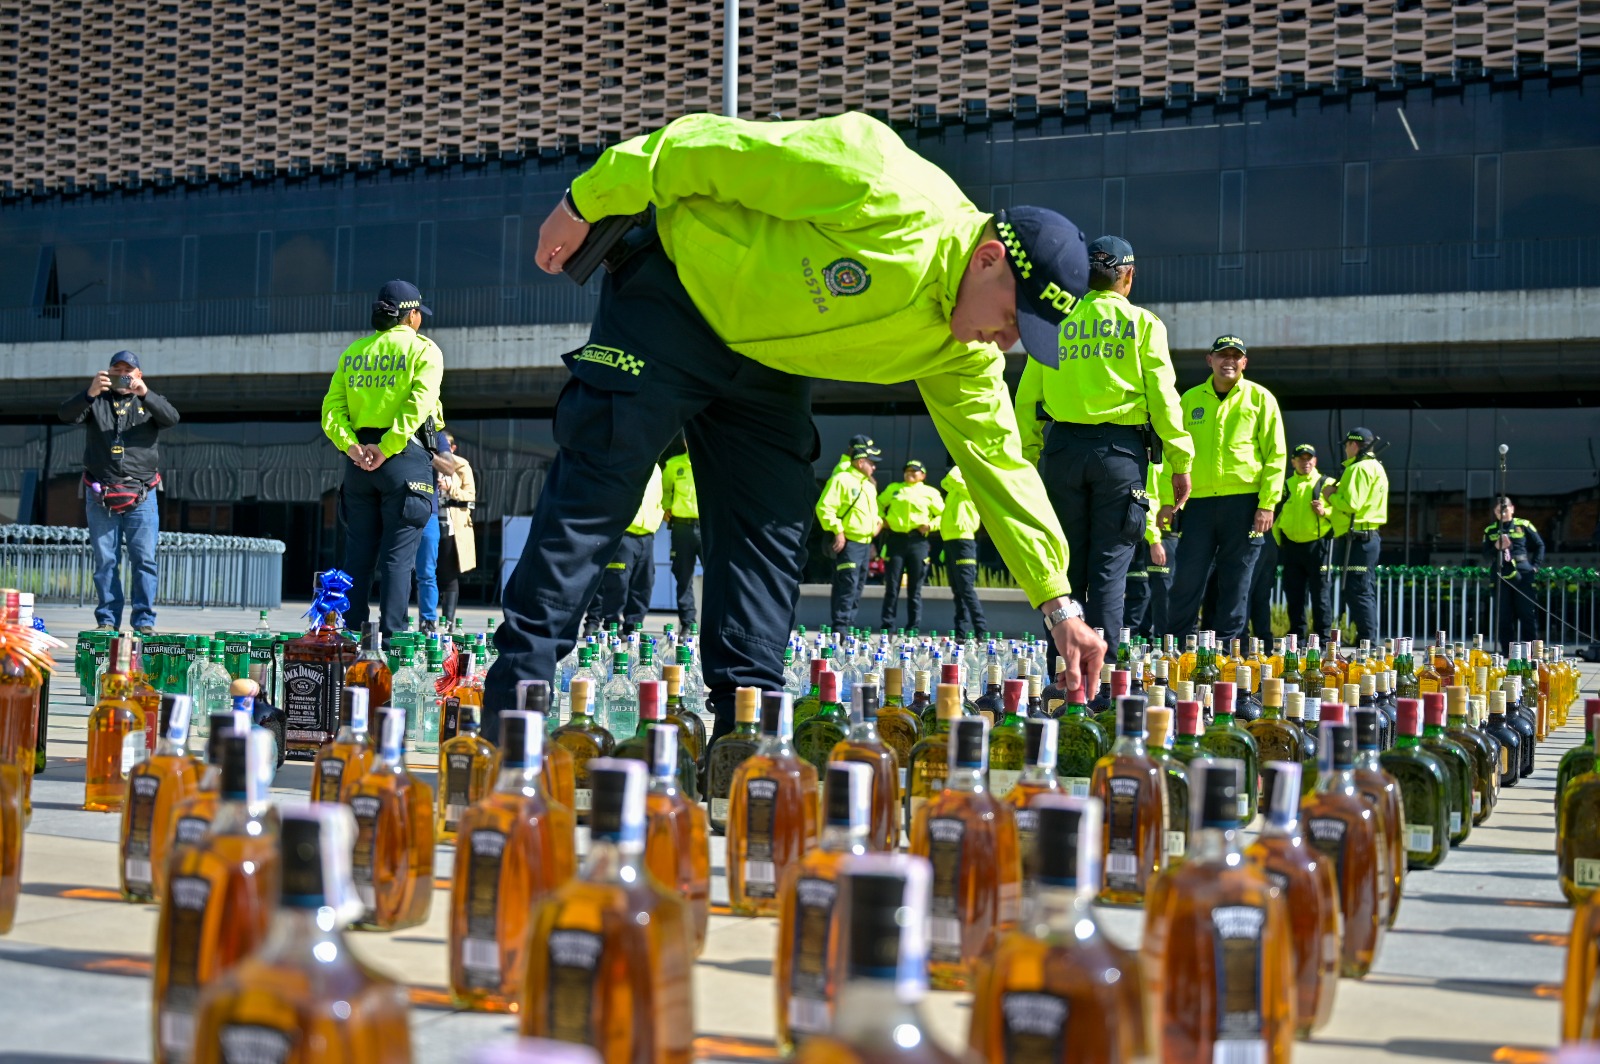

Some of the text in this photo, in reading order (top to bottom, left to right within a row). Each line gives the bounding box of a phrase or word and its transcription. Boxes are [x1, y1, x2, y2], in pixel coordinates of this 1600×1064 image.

[801, 257, 829, 314] 005784
[1059, 319, 1136, 340] OLICIA
[1059, 343, 1125, 361] 920456
[344, 354, 406, 372] POLICIA
[348, 374, 396, 388] 920124
[143, 645, 164, 654] NECTAR
[163, 646, 186, 655] NECTAR
[225, 645, 247, 653] NECTAR
[250, 650, 271, 659] NECTA
[283, 665, 324, 684] JACK DANIEL'S
